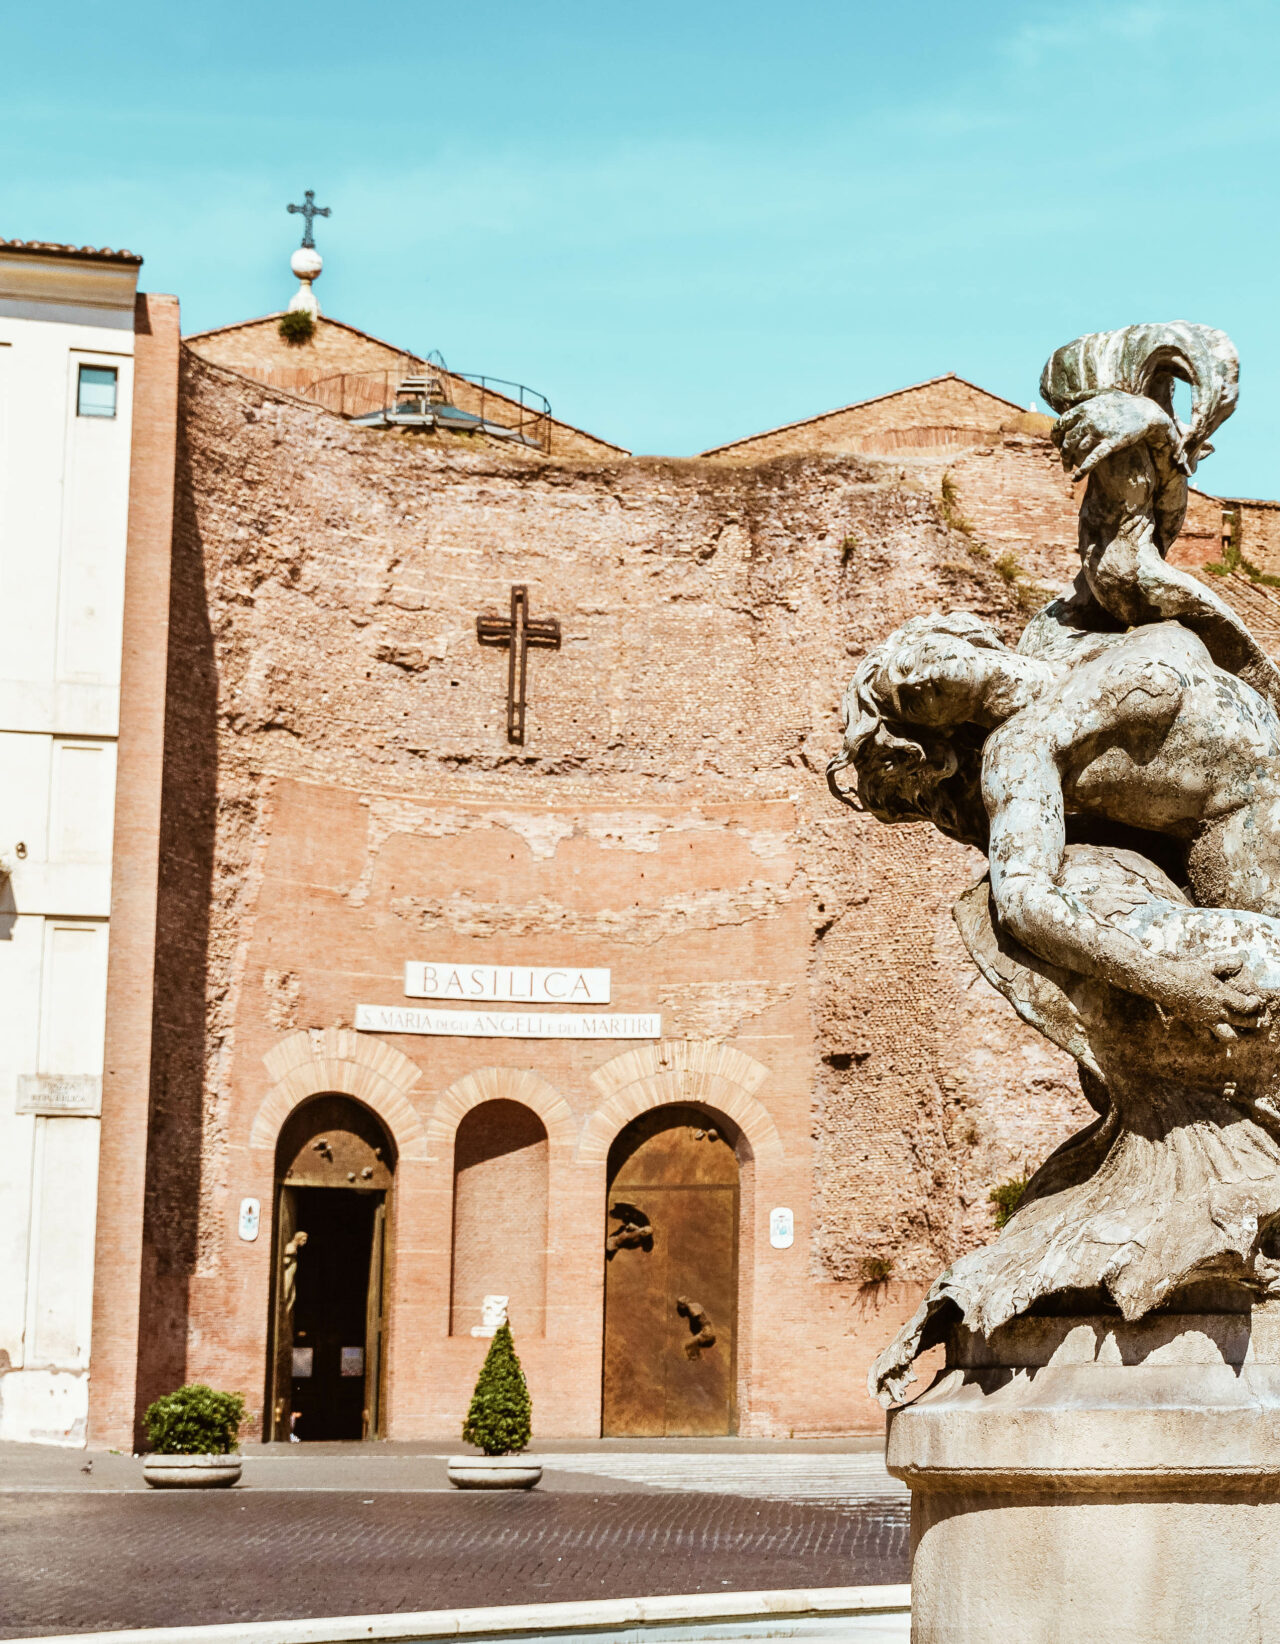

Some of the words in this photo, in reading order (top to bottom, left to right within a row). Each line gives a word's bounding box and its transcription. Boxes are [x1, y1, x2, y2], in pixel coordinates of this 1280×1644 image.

[423, 966, 591, 998] BASILICA
[380, 1011, 432, 1030] MARIA
[472, 1015, 542, 1033] ANGELI
[581, 1018, 653, 1034] MARTIRI
